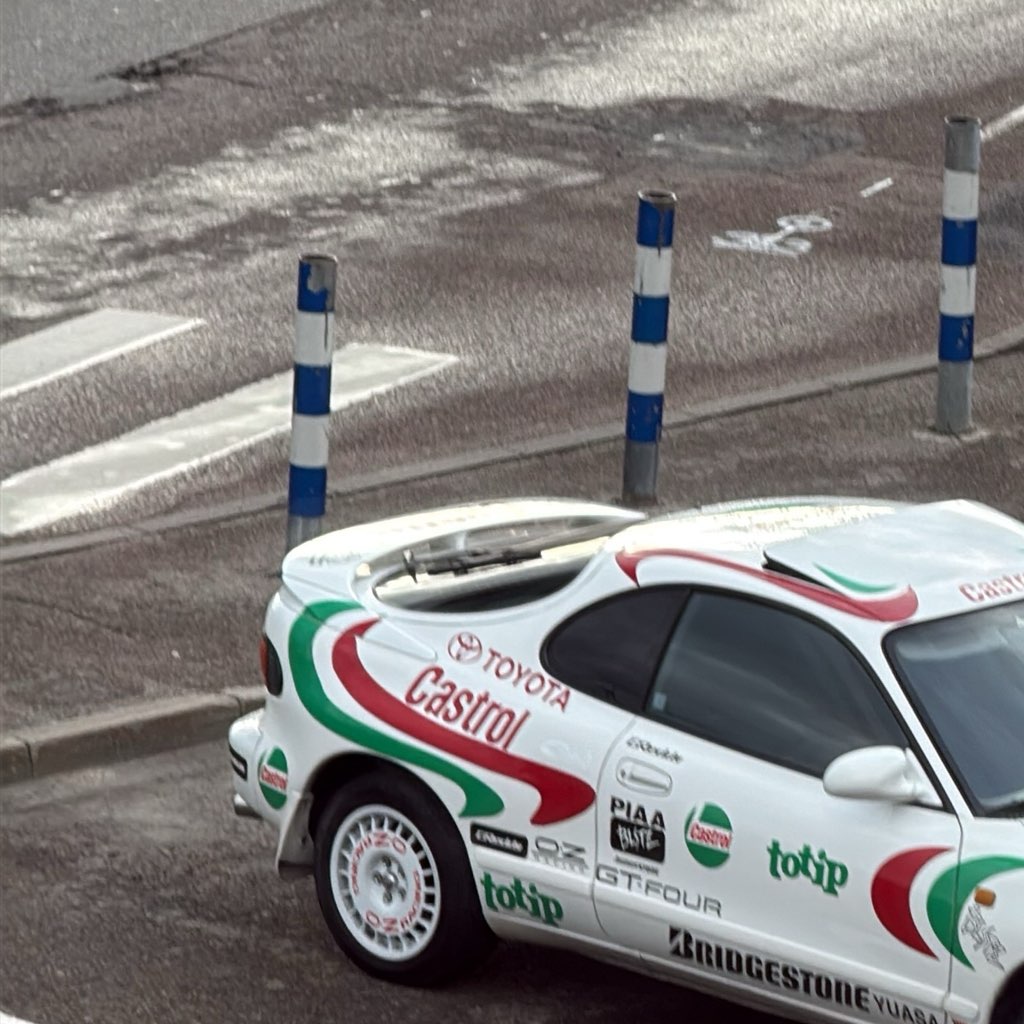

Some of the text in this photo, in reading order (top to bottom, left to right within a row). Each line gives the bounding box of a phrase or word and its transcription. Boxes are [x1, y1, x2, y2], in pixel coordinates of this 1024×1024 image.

[404, 664, 530, 751] Castrol
[481, 648, 573, 713] TOYOTA
[609, 795, 666, 831] PIAA
[689, 820, 733, 849] Castrol
[766, 838, 849, 898] totip
[479, 870, 564, 929] totip
[667, 926, 871, 1015] BRIDGESTONE
